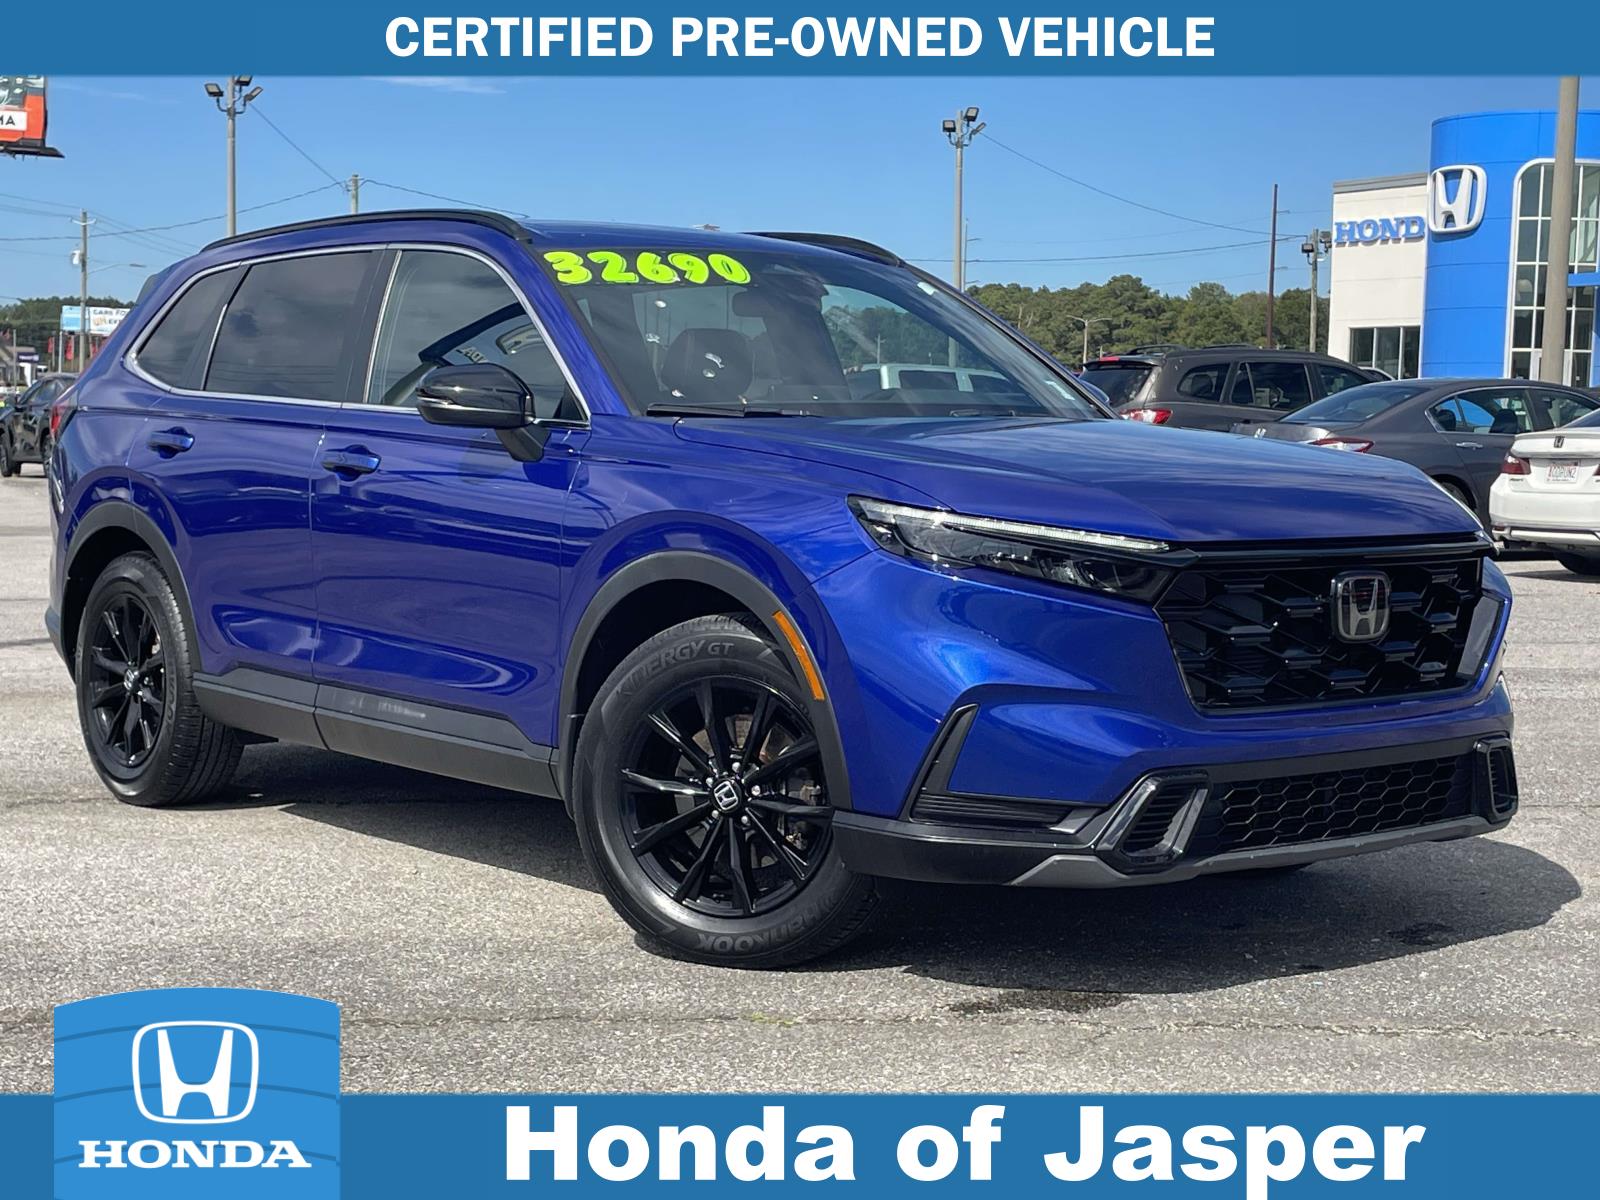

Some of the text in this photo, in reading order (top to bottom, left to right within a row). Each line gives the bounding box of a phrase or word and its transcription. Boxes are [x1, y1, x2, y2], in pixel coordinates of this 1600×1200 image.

[1334, 215, 1425, 248] HOND
[544, 251, 751, 285] 32690
[706, 641, 735, 656] GT
